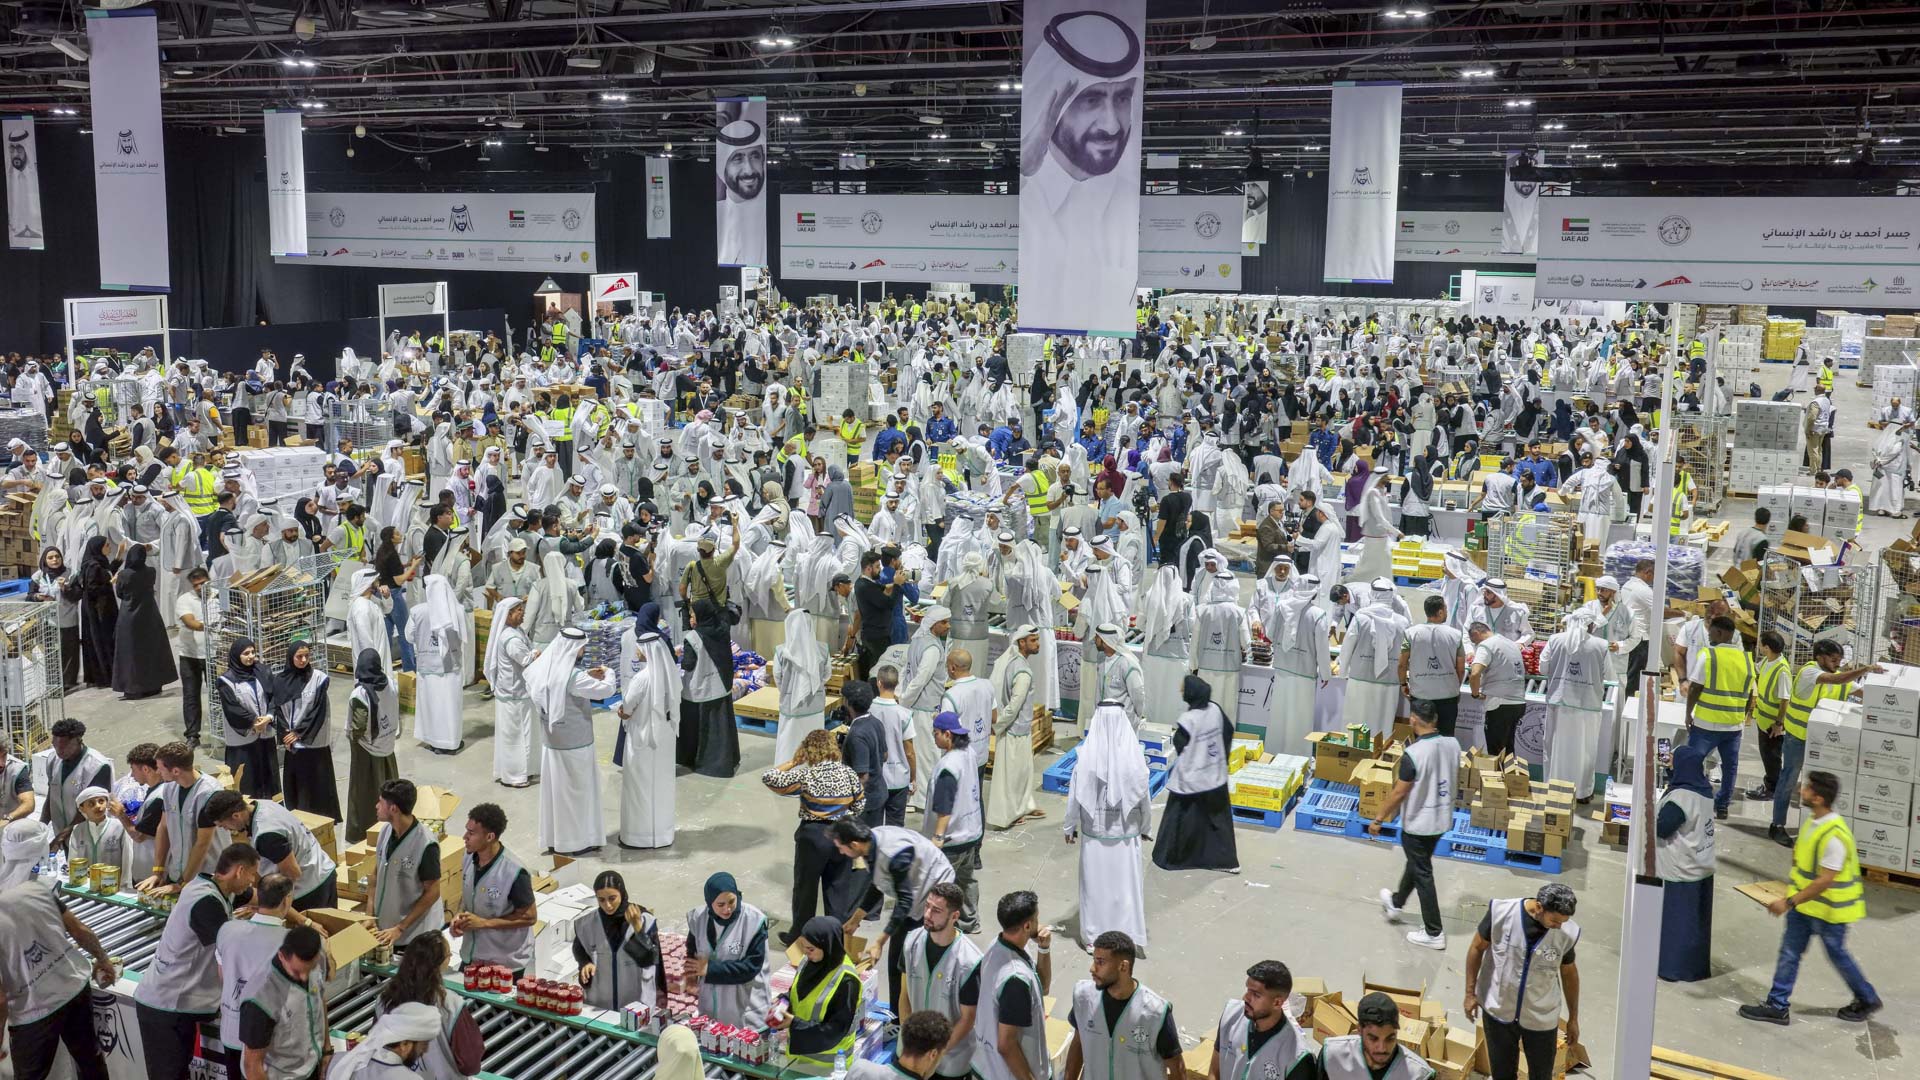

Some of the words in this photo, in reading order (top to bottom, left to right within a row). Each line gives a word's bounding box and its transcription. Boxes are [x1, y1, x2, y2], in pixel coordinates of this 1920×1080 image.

[959, 219, 978, 230] راشد
[979, 222, 988, 230] بن
[1008, 222, 1020, 230] سر
[1762, 229, 1806, 240] الإنساني
[1808, 228, 1836, 239] راشد
[1839, 229, 1852, 239] بن
[1855, 227, 1881, 238] أحمد
[1884, 230, 1911, 240] جسر
[613, 281, 625, 289] RTA
[1238, 687, 1256, 697] جس
